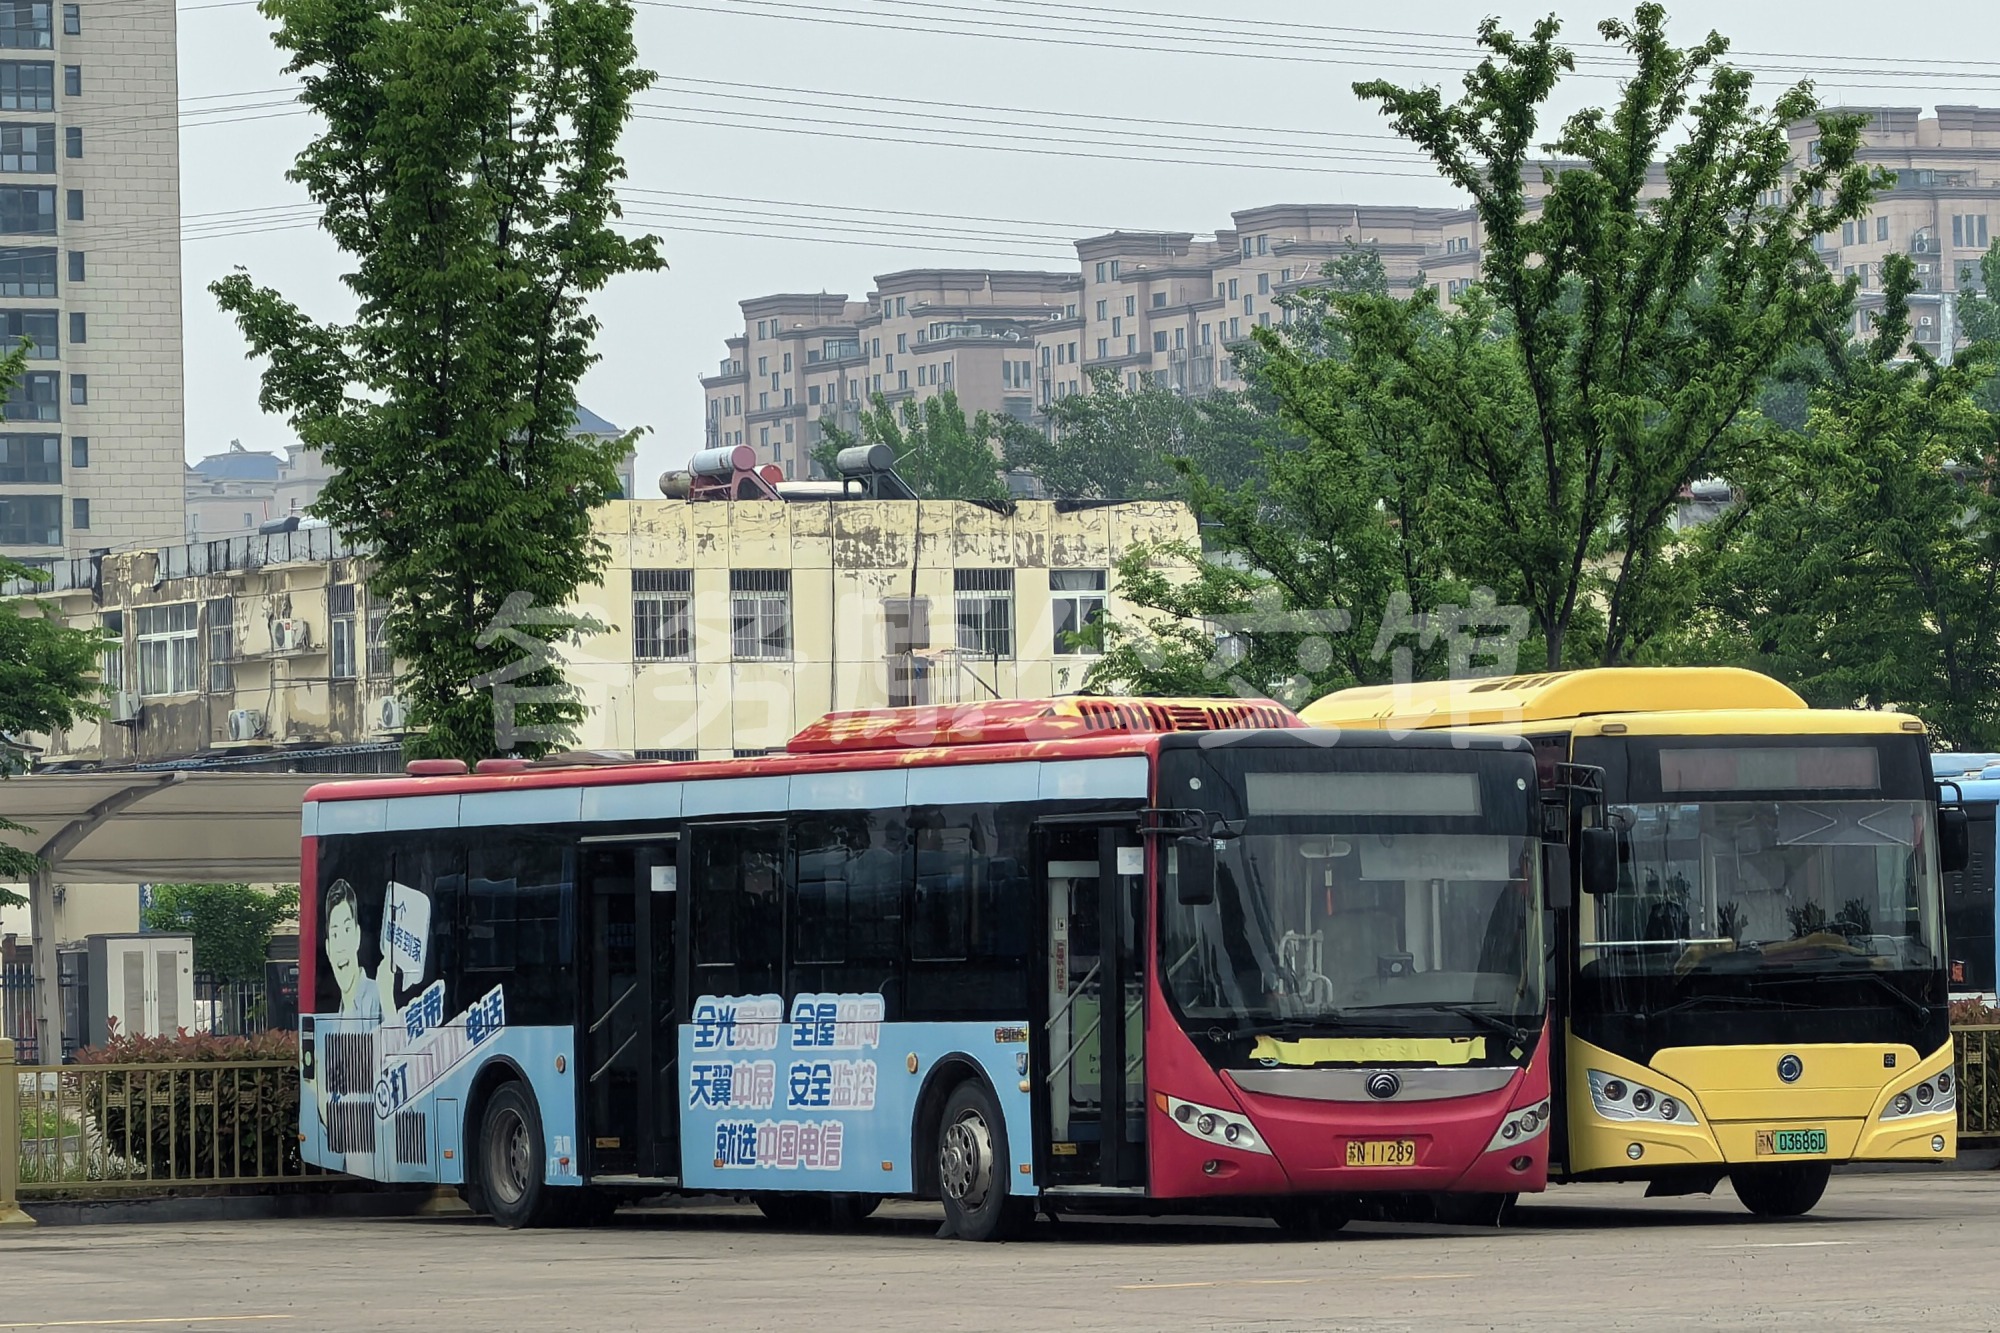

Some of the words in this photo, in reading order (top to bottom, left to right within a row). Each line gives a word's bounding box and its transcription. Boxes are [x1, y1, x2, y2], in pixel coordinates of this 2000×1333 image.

[405, 984, 441, 1045] 宽带
[466, 989, 502, 1045] 电话
[788, 1063, 875, 1106] 安全监控
[716, 1123, 842, 1167] 就选中国电信
